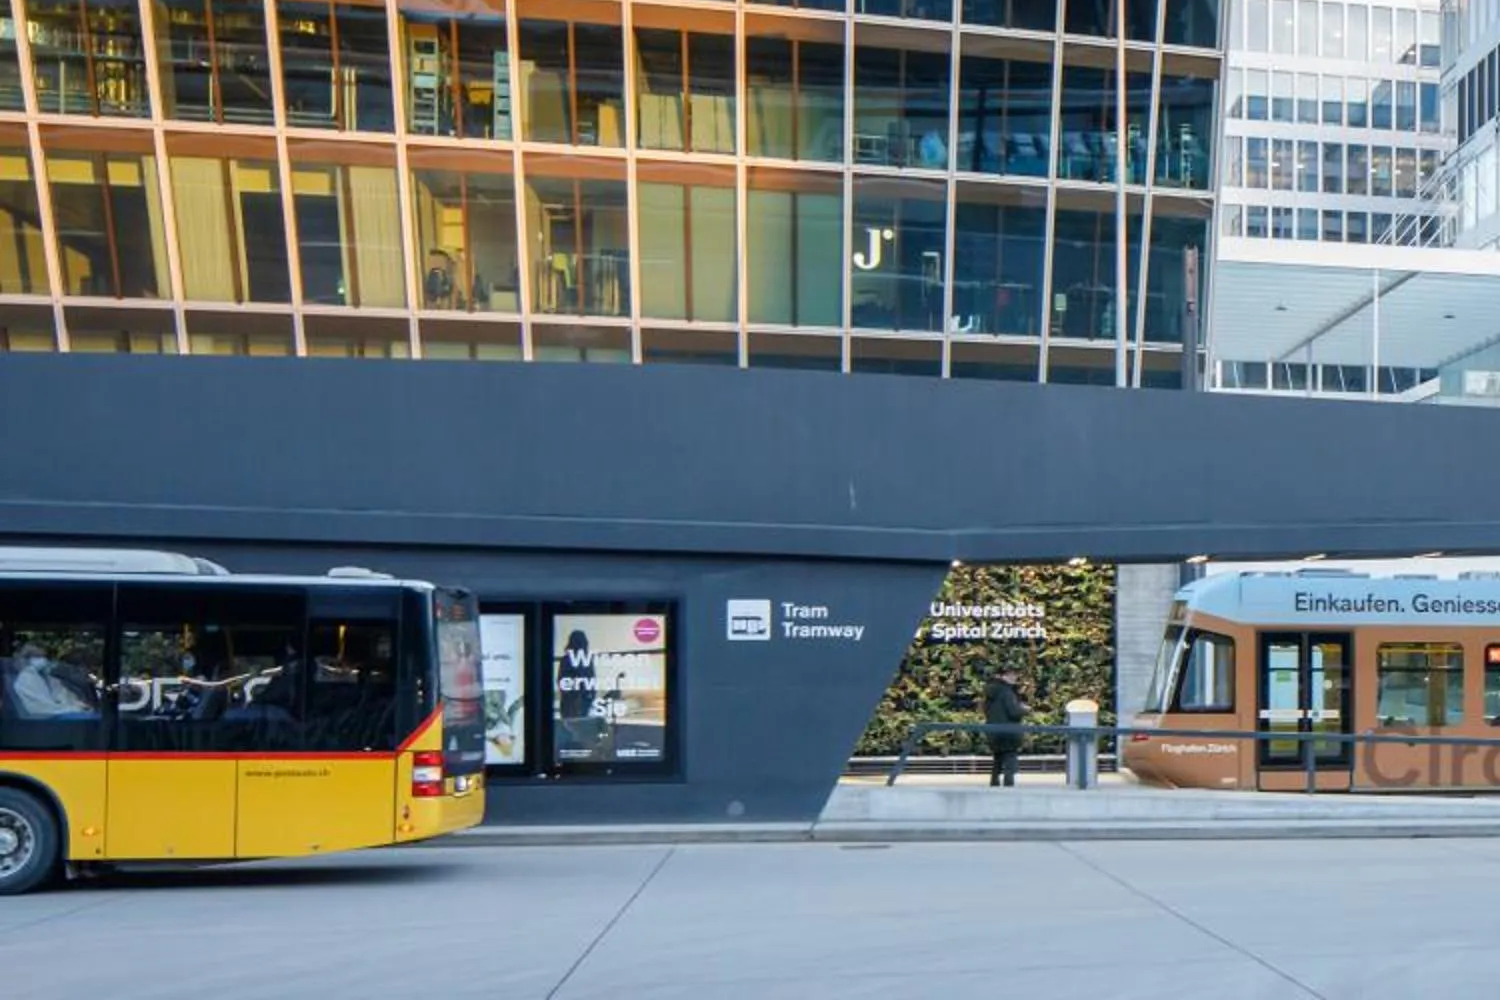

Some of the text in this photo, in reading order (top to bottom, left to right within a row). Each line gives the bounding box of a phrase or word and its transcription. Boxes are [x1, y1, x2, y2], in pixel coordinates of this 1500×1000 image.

[782, 602, 828, 618] Tram
[1294, 592, 1405, 613] Einkaufen.
[782, 621, 865, 640] Tramway
[932, 622, 1047, 641] Spital Zürich
